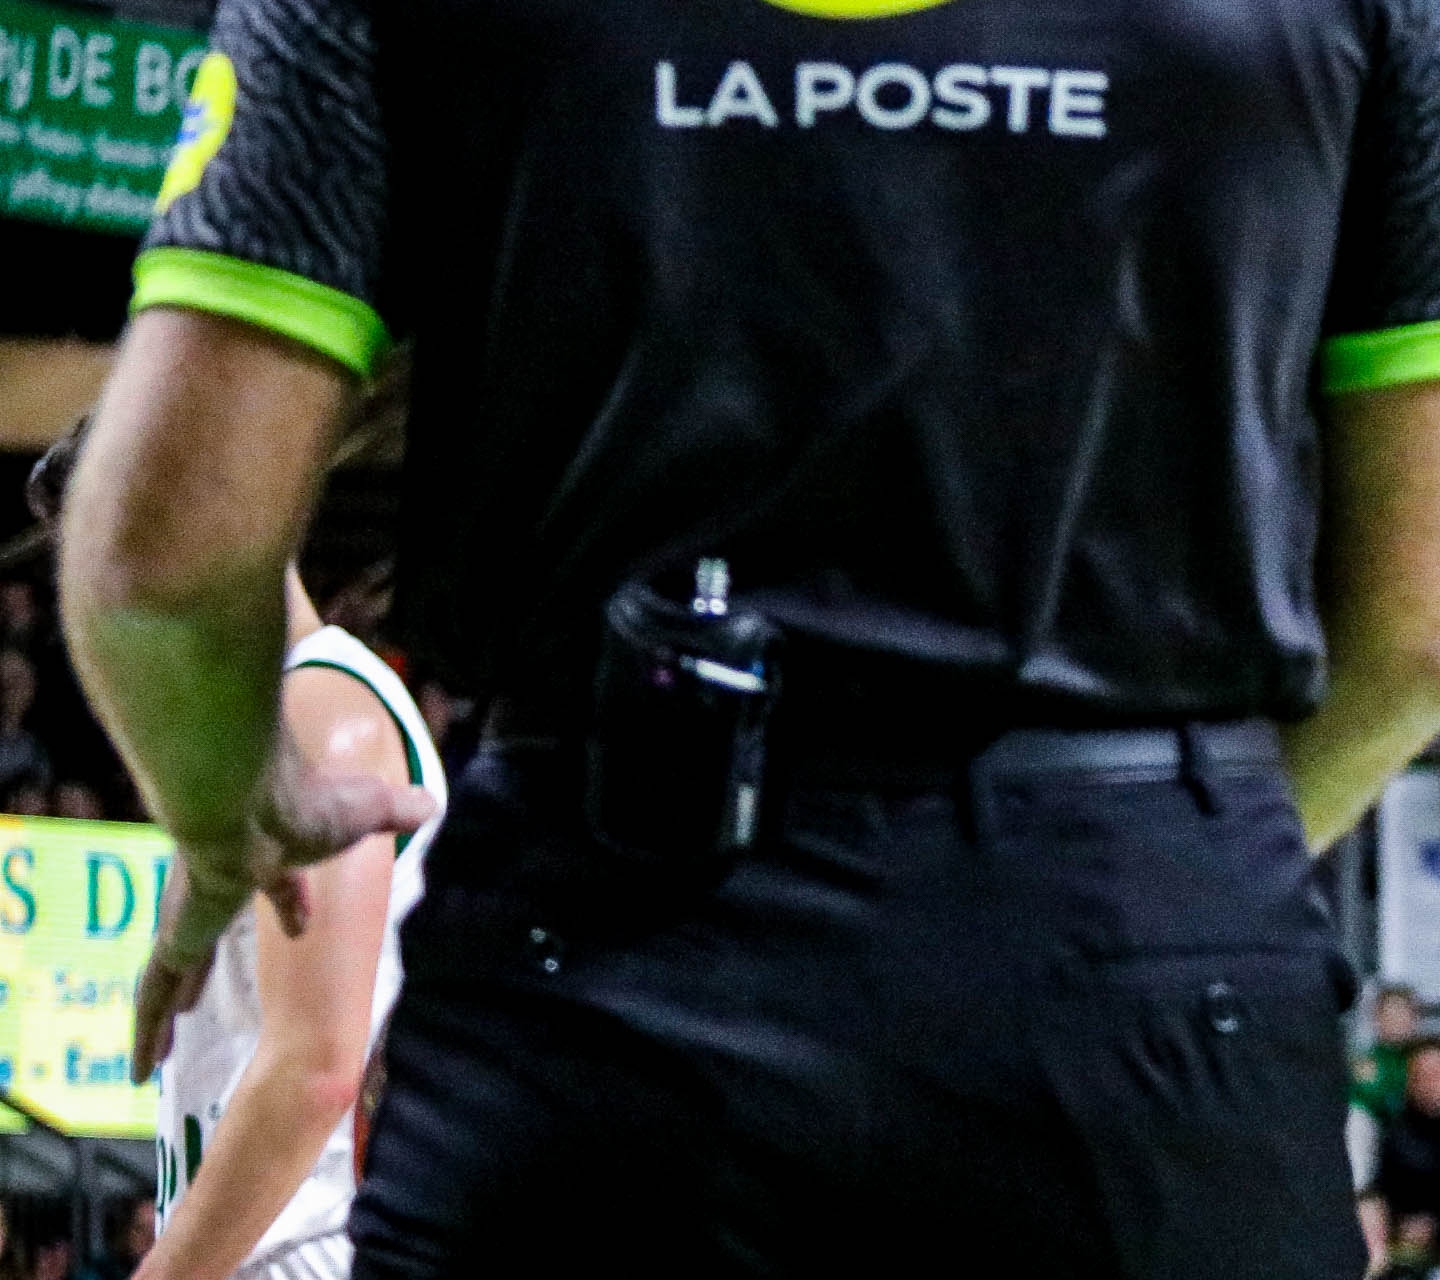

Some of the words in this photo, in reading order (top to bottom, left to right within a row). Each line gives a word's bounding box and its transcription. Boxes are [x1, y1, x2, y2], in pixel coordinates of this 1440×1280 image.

[48, 25, 115, 107] DE
[656, 60, 779, 129] LA
[796, 62, 1108, 138] POSTE
